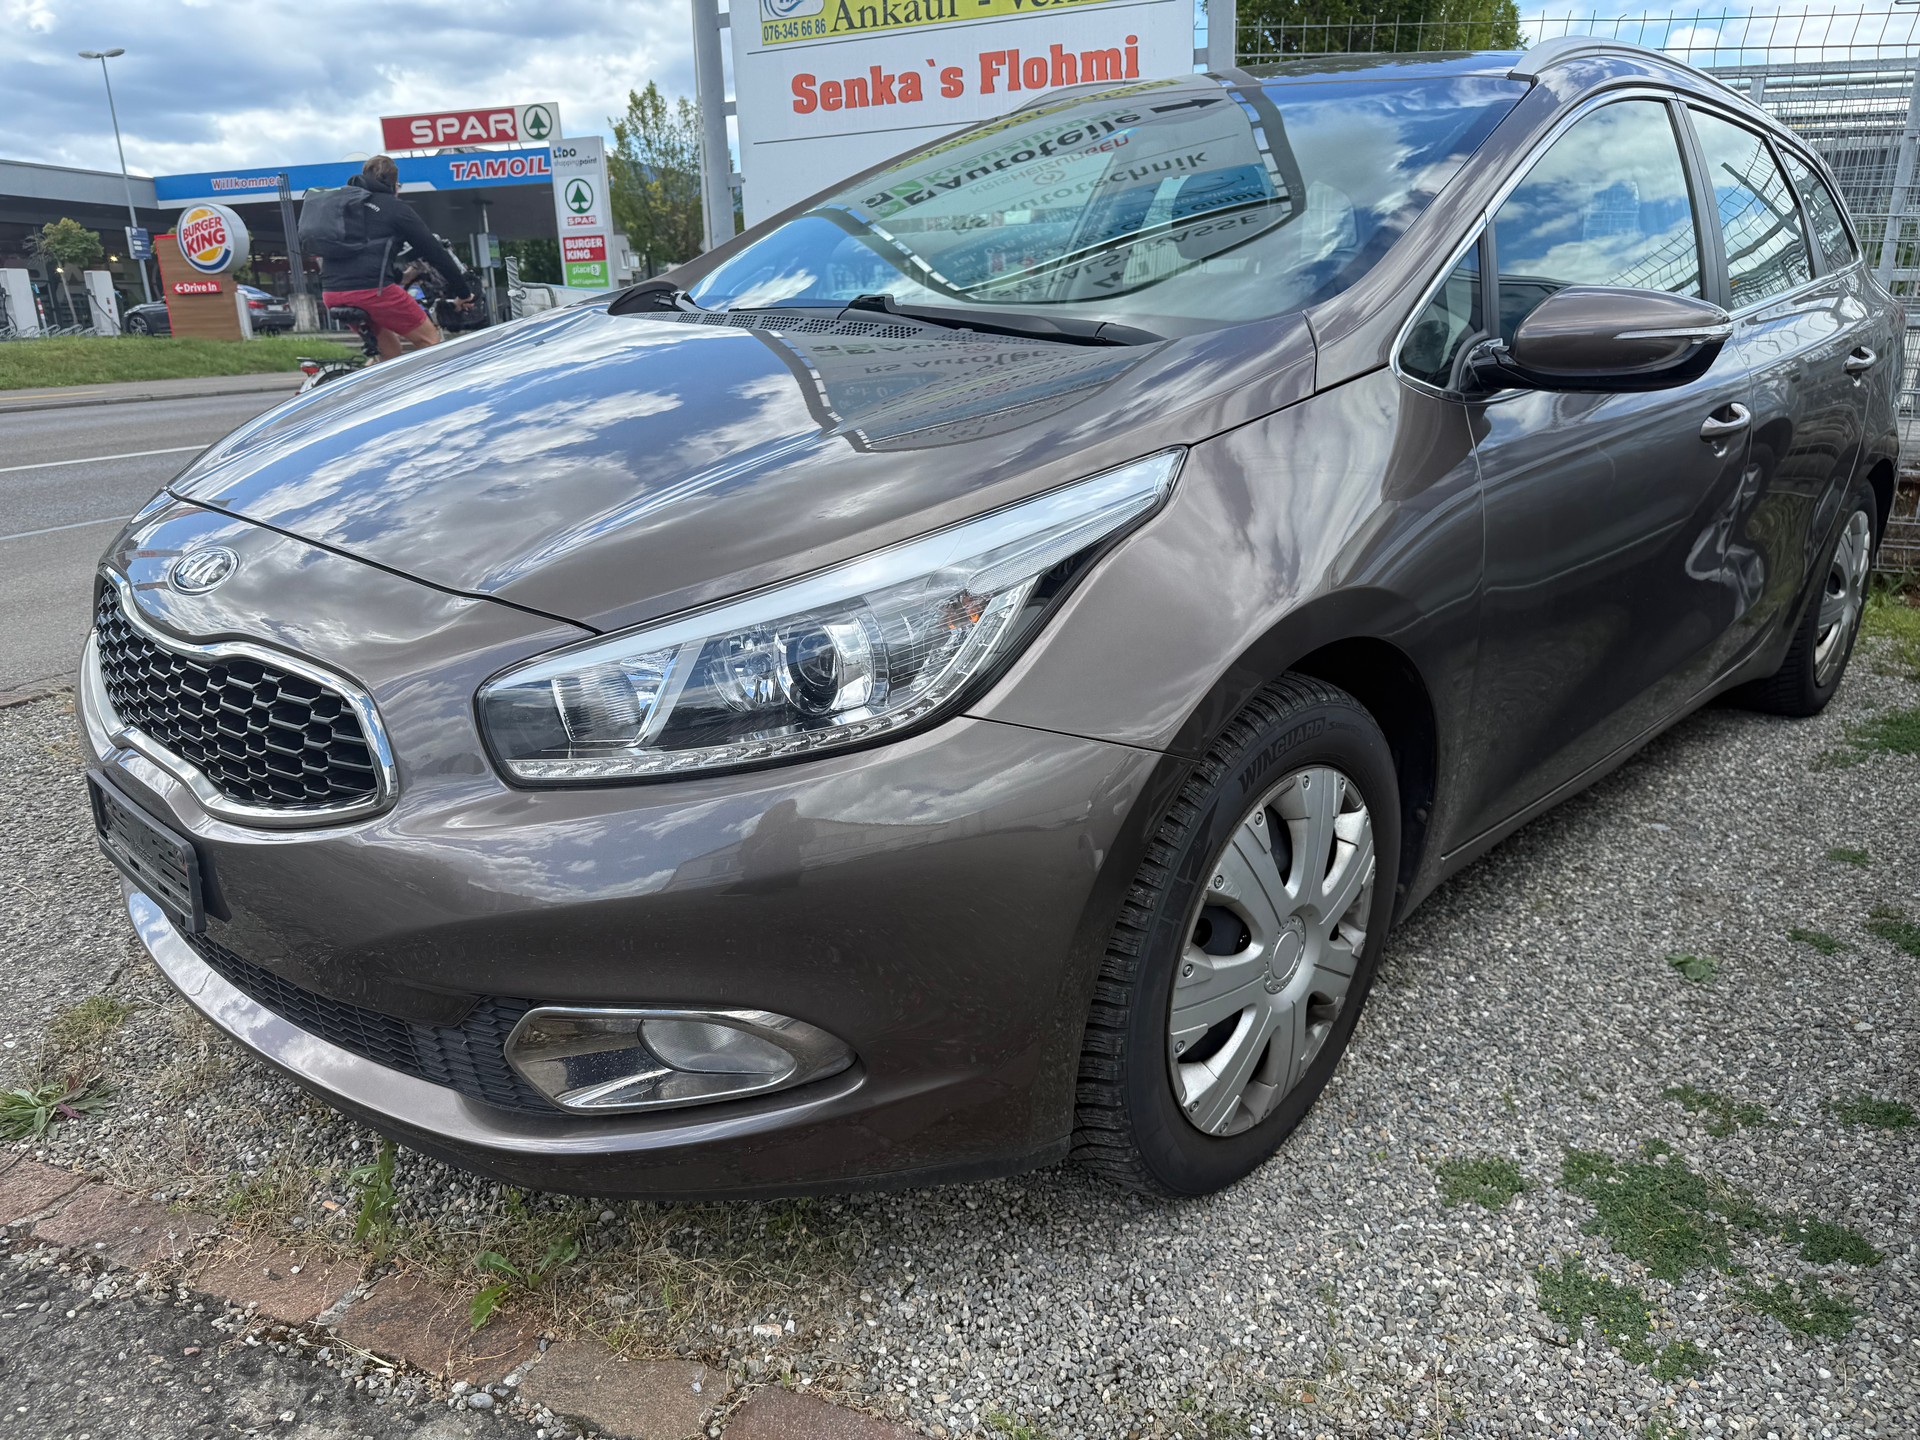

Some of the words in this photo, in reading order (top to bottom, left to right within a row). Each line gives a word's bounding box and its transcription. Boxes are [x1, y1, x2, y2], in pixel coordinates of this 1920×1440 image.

[763, 23, 799, 42] 076-345
[801, 21, 813, 36] 66
[815, 18, 826, 34] 86
[979, 34, 1140, 95] Flohmi
[410, 113, 515, 144] SPAR
[450, 156, 551, 181] TAMOIL
[182, 216, 222, 242] BURGER
[568, 216, 596, 226] SPAR
[185, 228, 226, 258] KING
[565, 237, 603, 249] BURGER
[183, 283, 205, 293] Drive
[207, 282, 217, 291] In
[1237, 716, 1327, 796] WINGUARD
